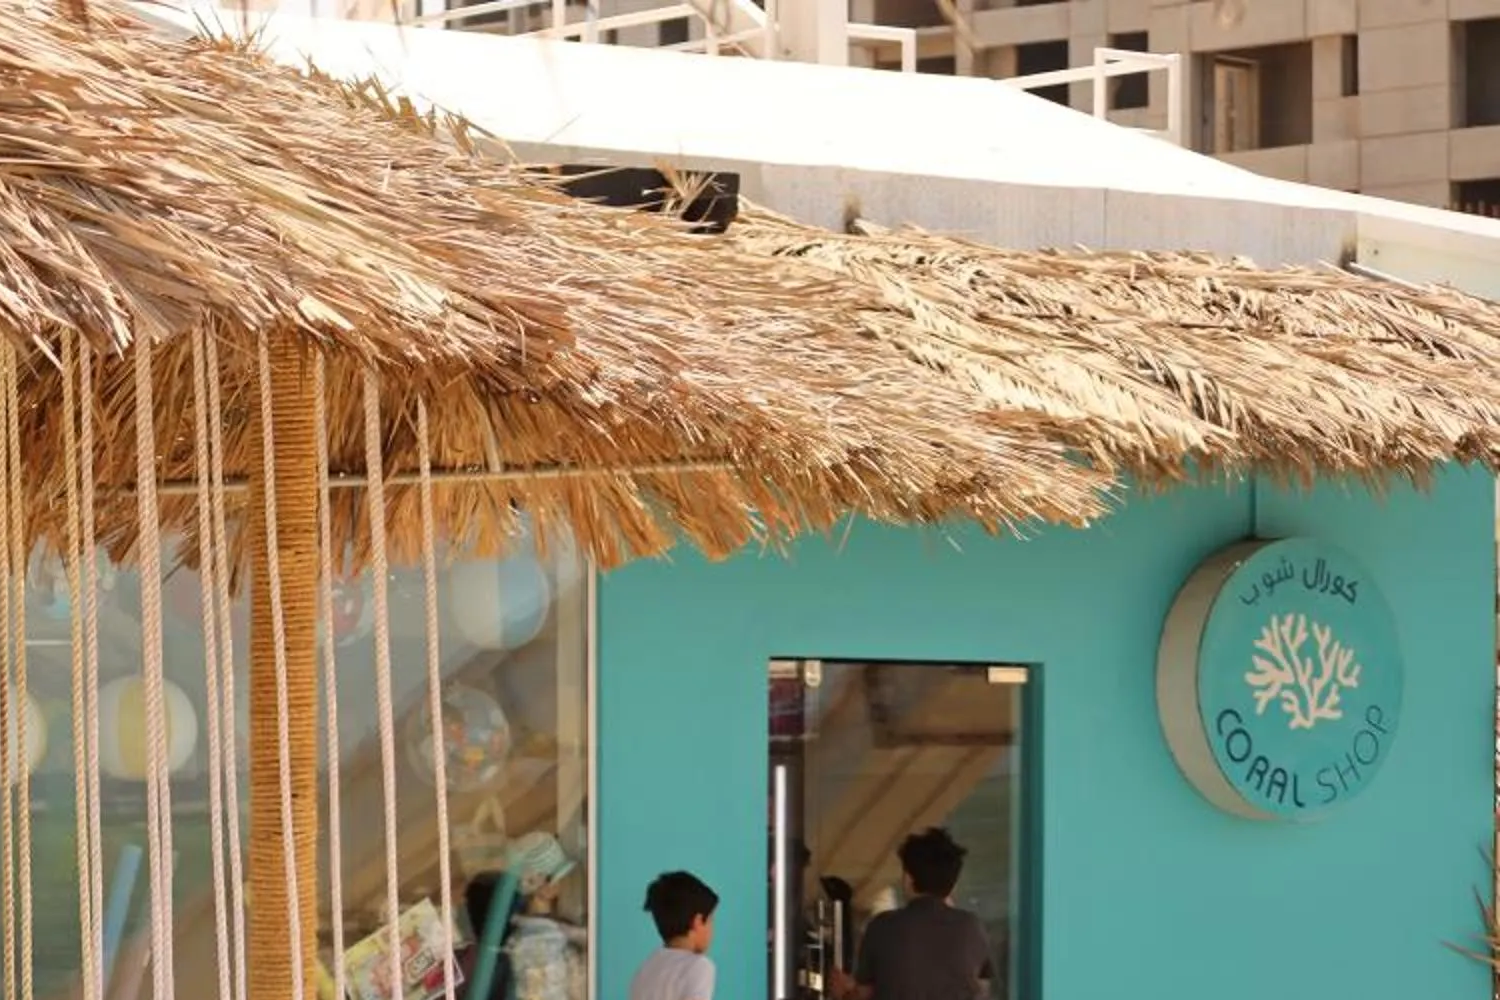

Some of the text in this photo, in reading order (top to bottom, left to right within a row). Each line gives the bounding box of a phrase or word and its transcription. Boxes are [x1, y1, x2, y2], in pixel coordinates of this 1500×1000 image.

[1238, 556, 1360, 606] كورال شوب
[1216, 705, 1389, 808] CORAL SHOP
